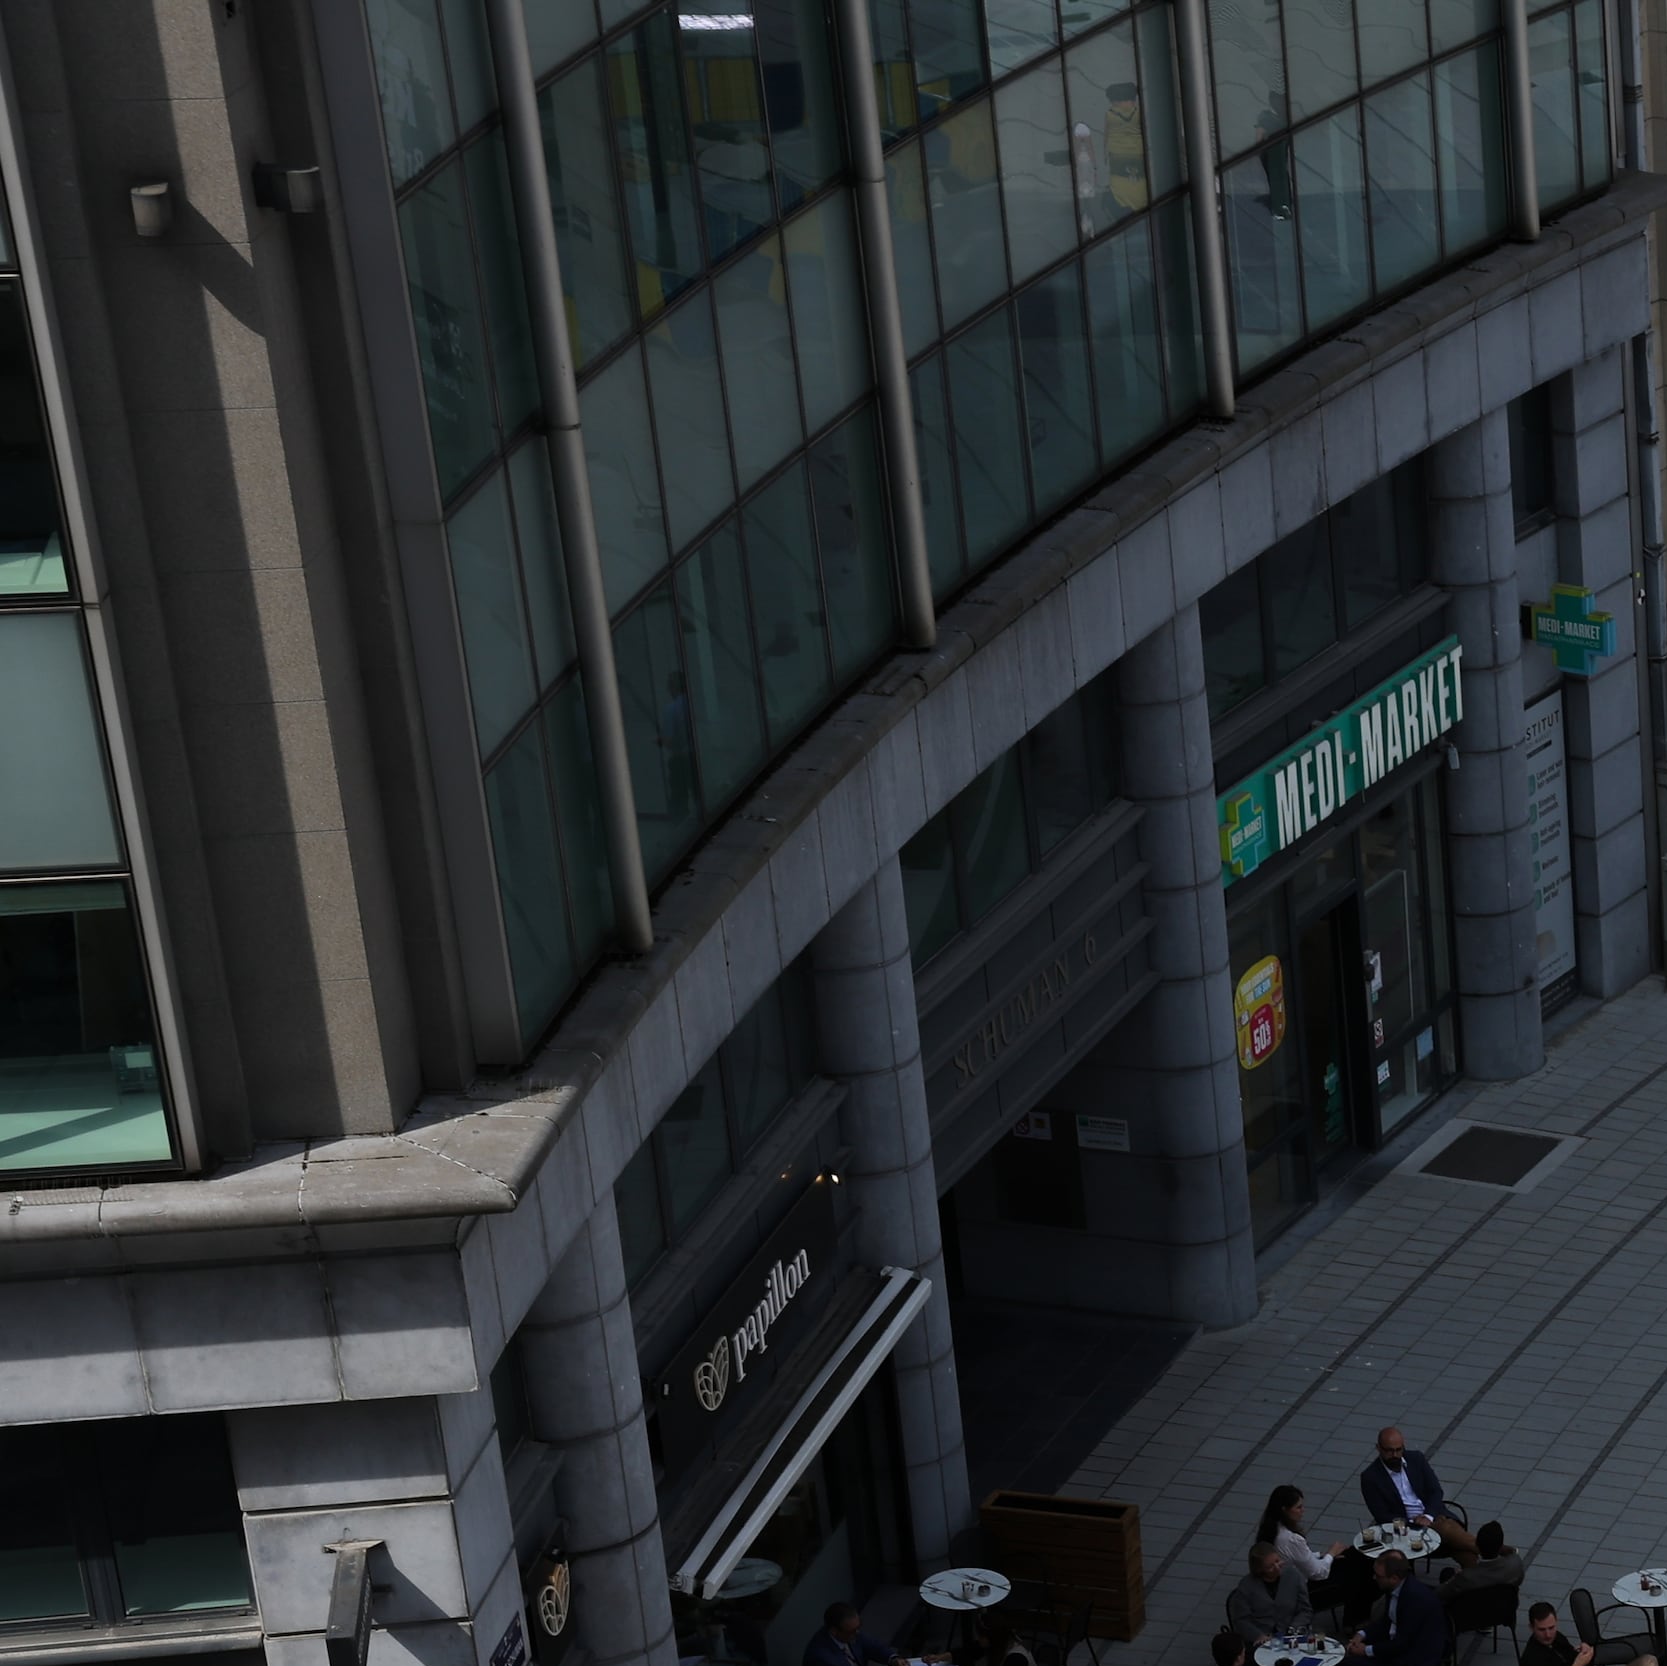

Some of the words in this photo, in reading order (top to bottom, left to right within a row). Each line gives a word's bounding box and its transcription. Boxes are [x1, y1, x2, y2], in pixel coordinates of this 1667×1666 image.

[1274, 643, 1464, 851] MEDI-MARKET
[953, 952, 1071, 1090] SCHUMAN
[731, 1248, 811, 1383] papillon
